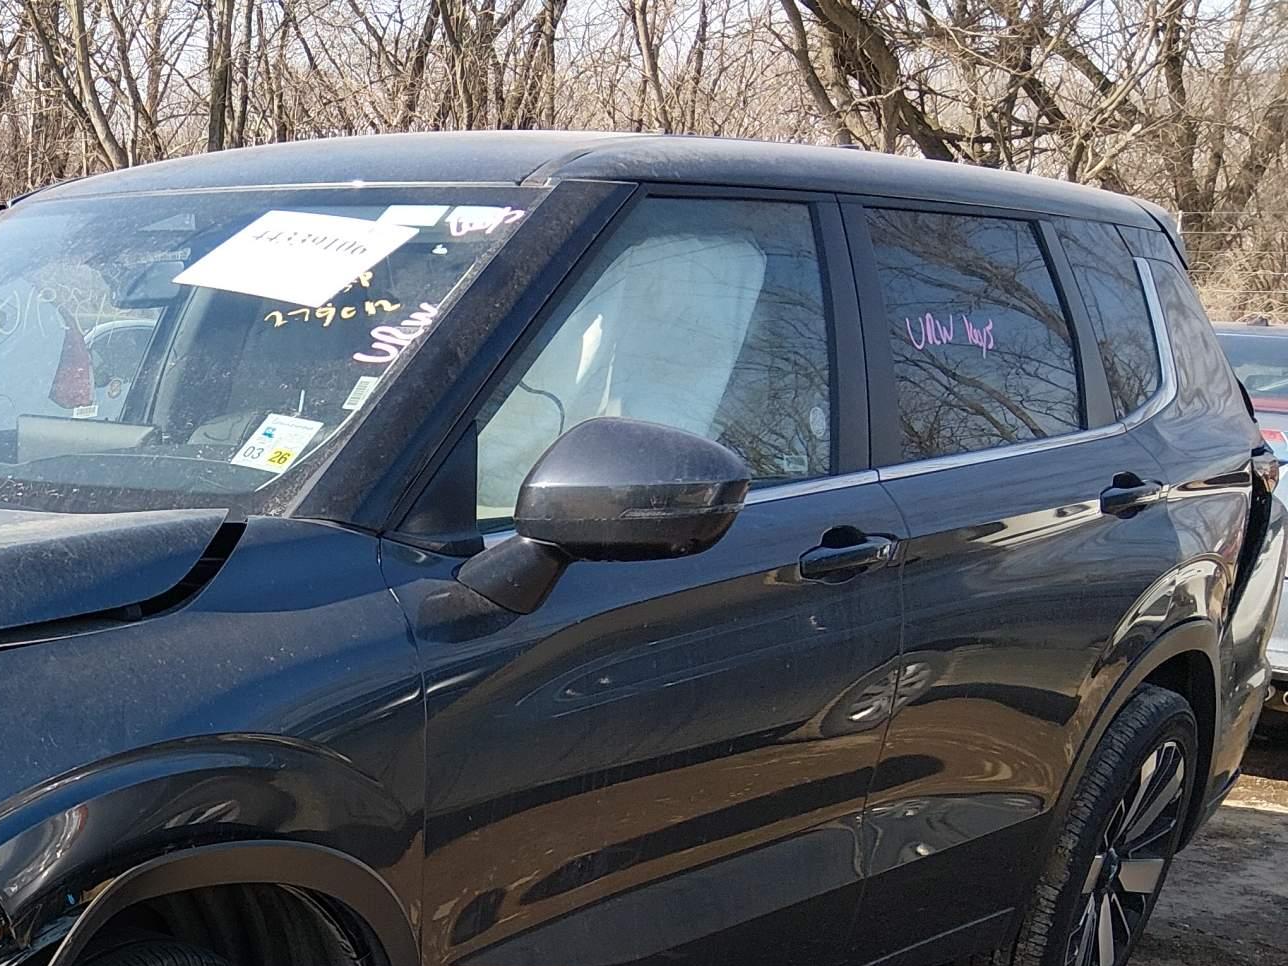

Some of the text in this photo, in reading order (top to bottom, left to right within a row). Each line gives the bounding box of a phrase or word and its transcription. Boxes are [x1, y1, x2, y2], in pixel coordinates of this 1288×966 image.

[905, 312, 954, 351] URW
[242, 444, 291, 465] 03 26
